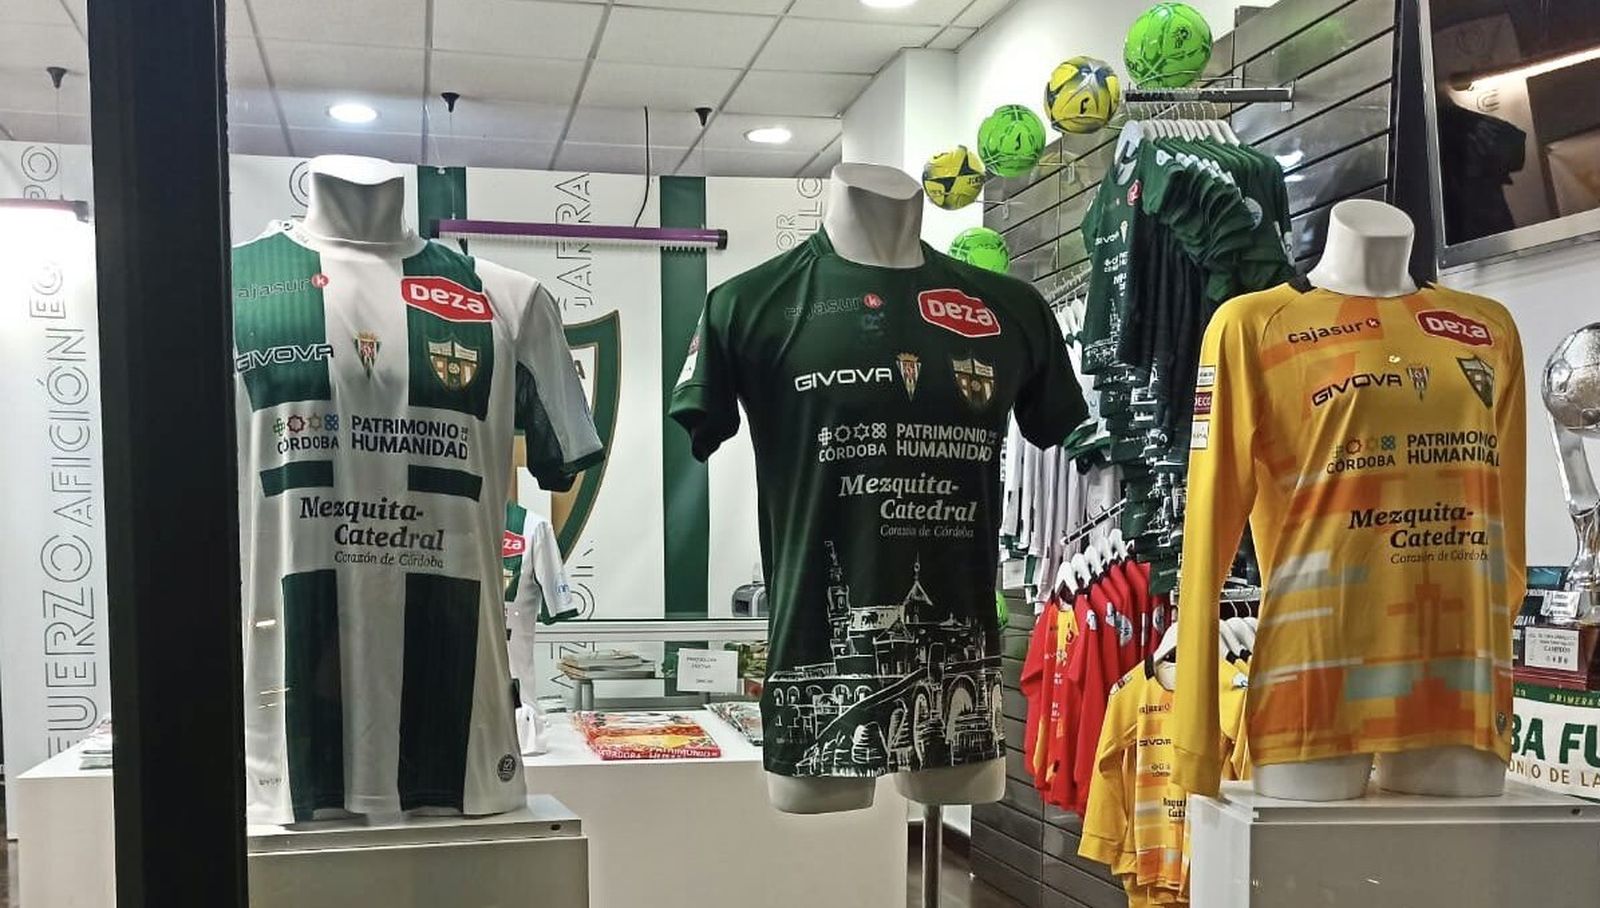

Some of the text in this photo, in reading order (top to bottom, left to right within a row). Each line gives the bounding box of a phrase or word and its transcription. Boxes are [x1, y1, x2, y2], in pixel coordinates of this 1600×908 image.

[410, 283, 485, 314] Deza
[927, 299, 994, 327] Deza
[1288, 321, 1363, 344] cajasur
[1426, 316, 1487, 339] Deza
[236, 344, 334, 373] GIVOVA
[794, 367, 893, 392] GIVOVA
[1312, 373, 1402, 406] GIVOVA
[37, 328, 93, 528] AFICIÓN
[351, 415, 459, 438] PATRIMONIO
[897, 423, 987, 444] PATRIMONIO
[352, 433, 468, 460] HUMANIDAD
[897, 440, 992, 462] HUMANIDAD
[838, 472, 960, 499] Mezquita-
[300, 496, 424, 524] Mezquita-
[880, 499, 977, 522] Catedral
[1348, 502, 1473, 530] Mezquita-
[334, 523, 445, 550] Catedral
[1390, 526, 1489, 548] Catedra
[380, 552, 394, 565] de
[40, 535, 98, 758] UERZO
[1549, 767, 1570, 784] DE
